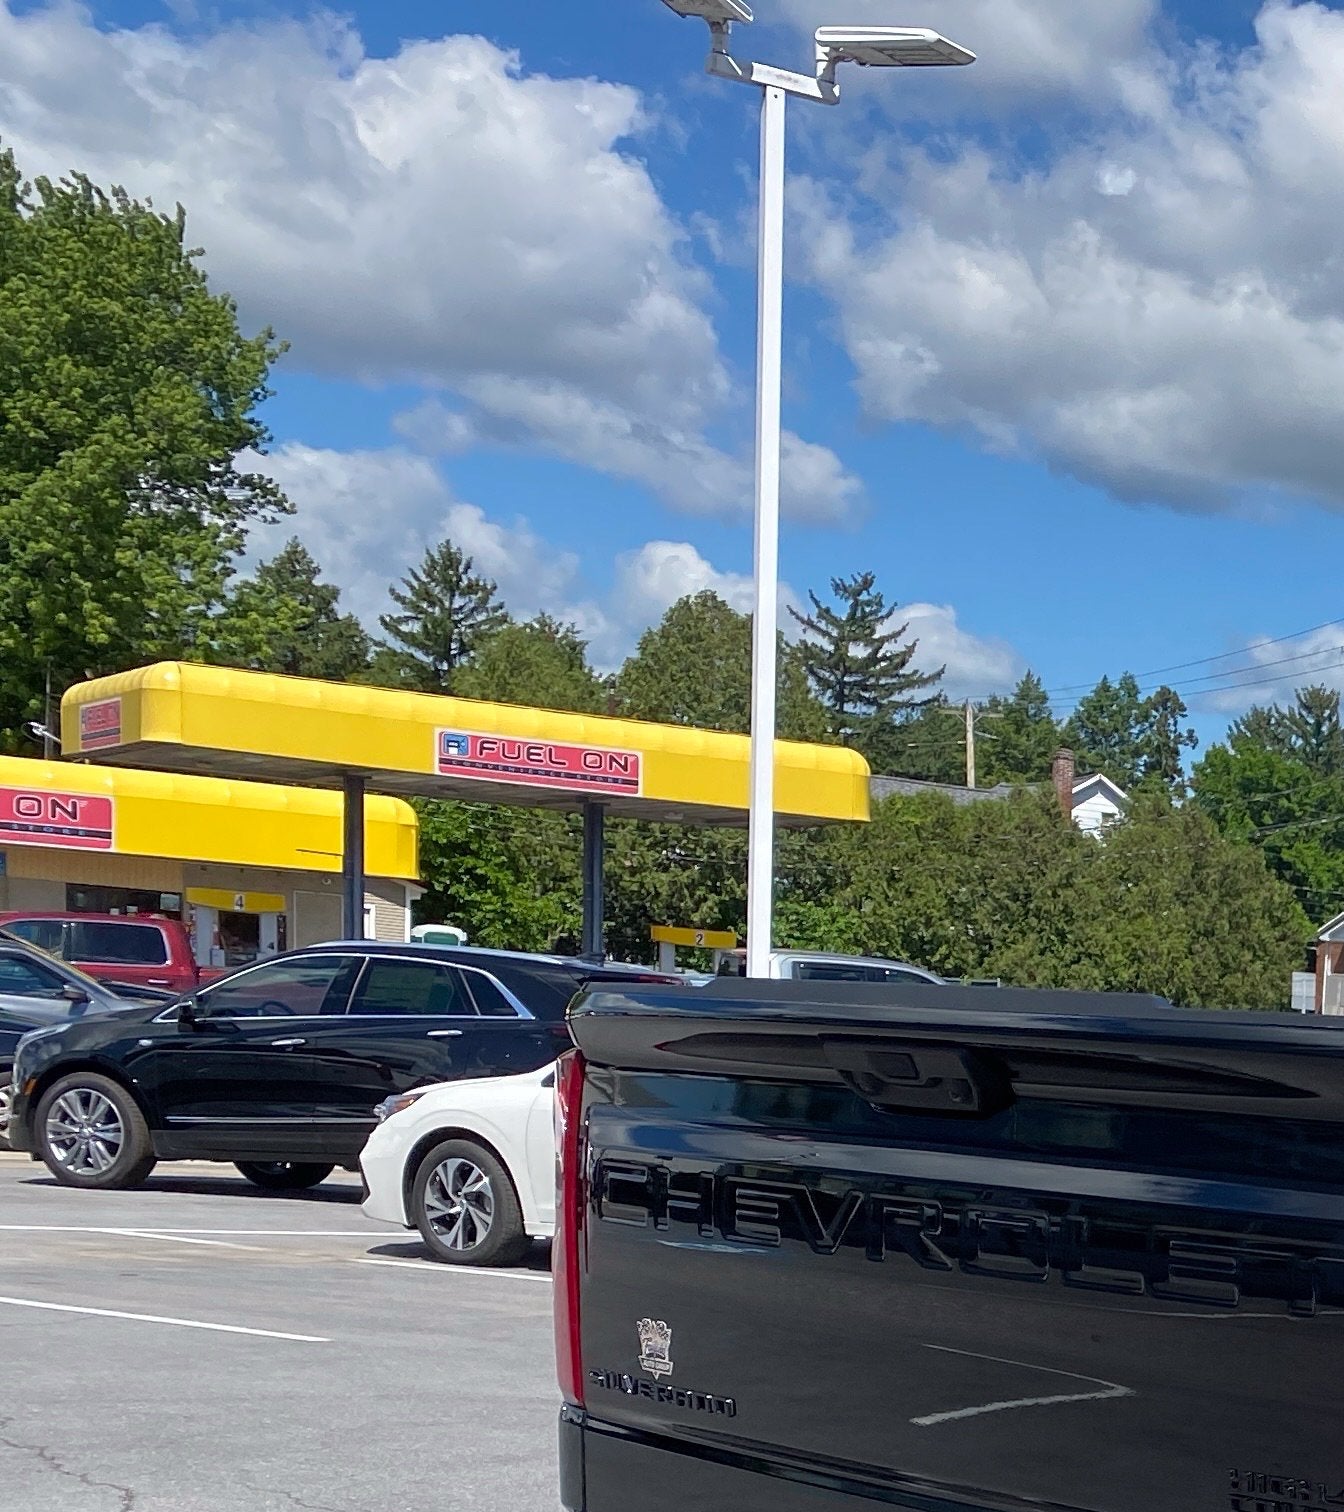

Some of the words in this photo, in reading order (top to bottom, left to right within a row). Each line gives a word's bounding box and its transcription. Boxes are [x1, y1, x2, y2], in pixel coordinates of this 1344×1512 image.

[477, 738, 567, 767] FUEL
[582, 750, 630, 773] ON
[13, 795, 79, 821] ON
[236, 895, 244, 908] 4
[696, 934, 704, 946] 2
[589, 1368, 737, 1418] SILVERADO
